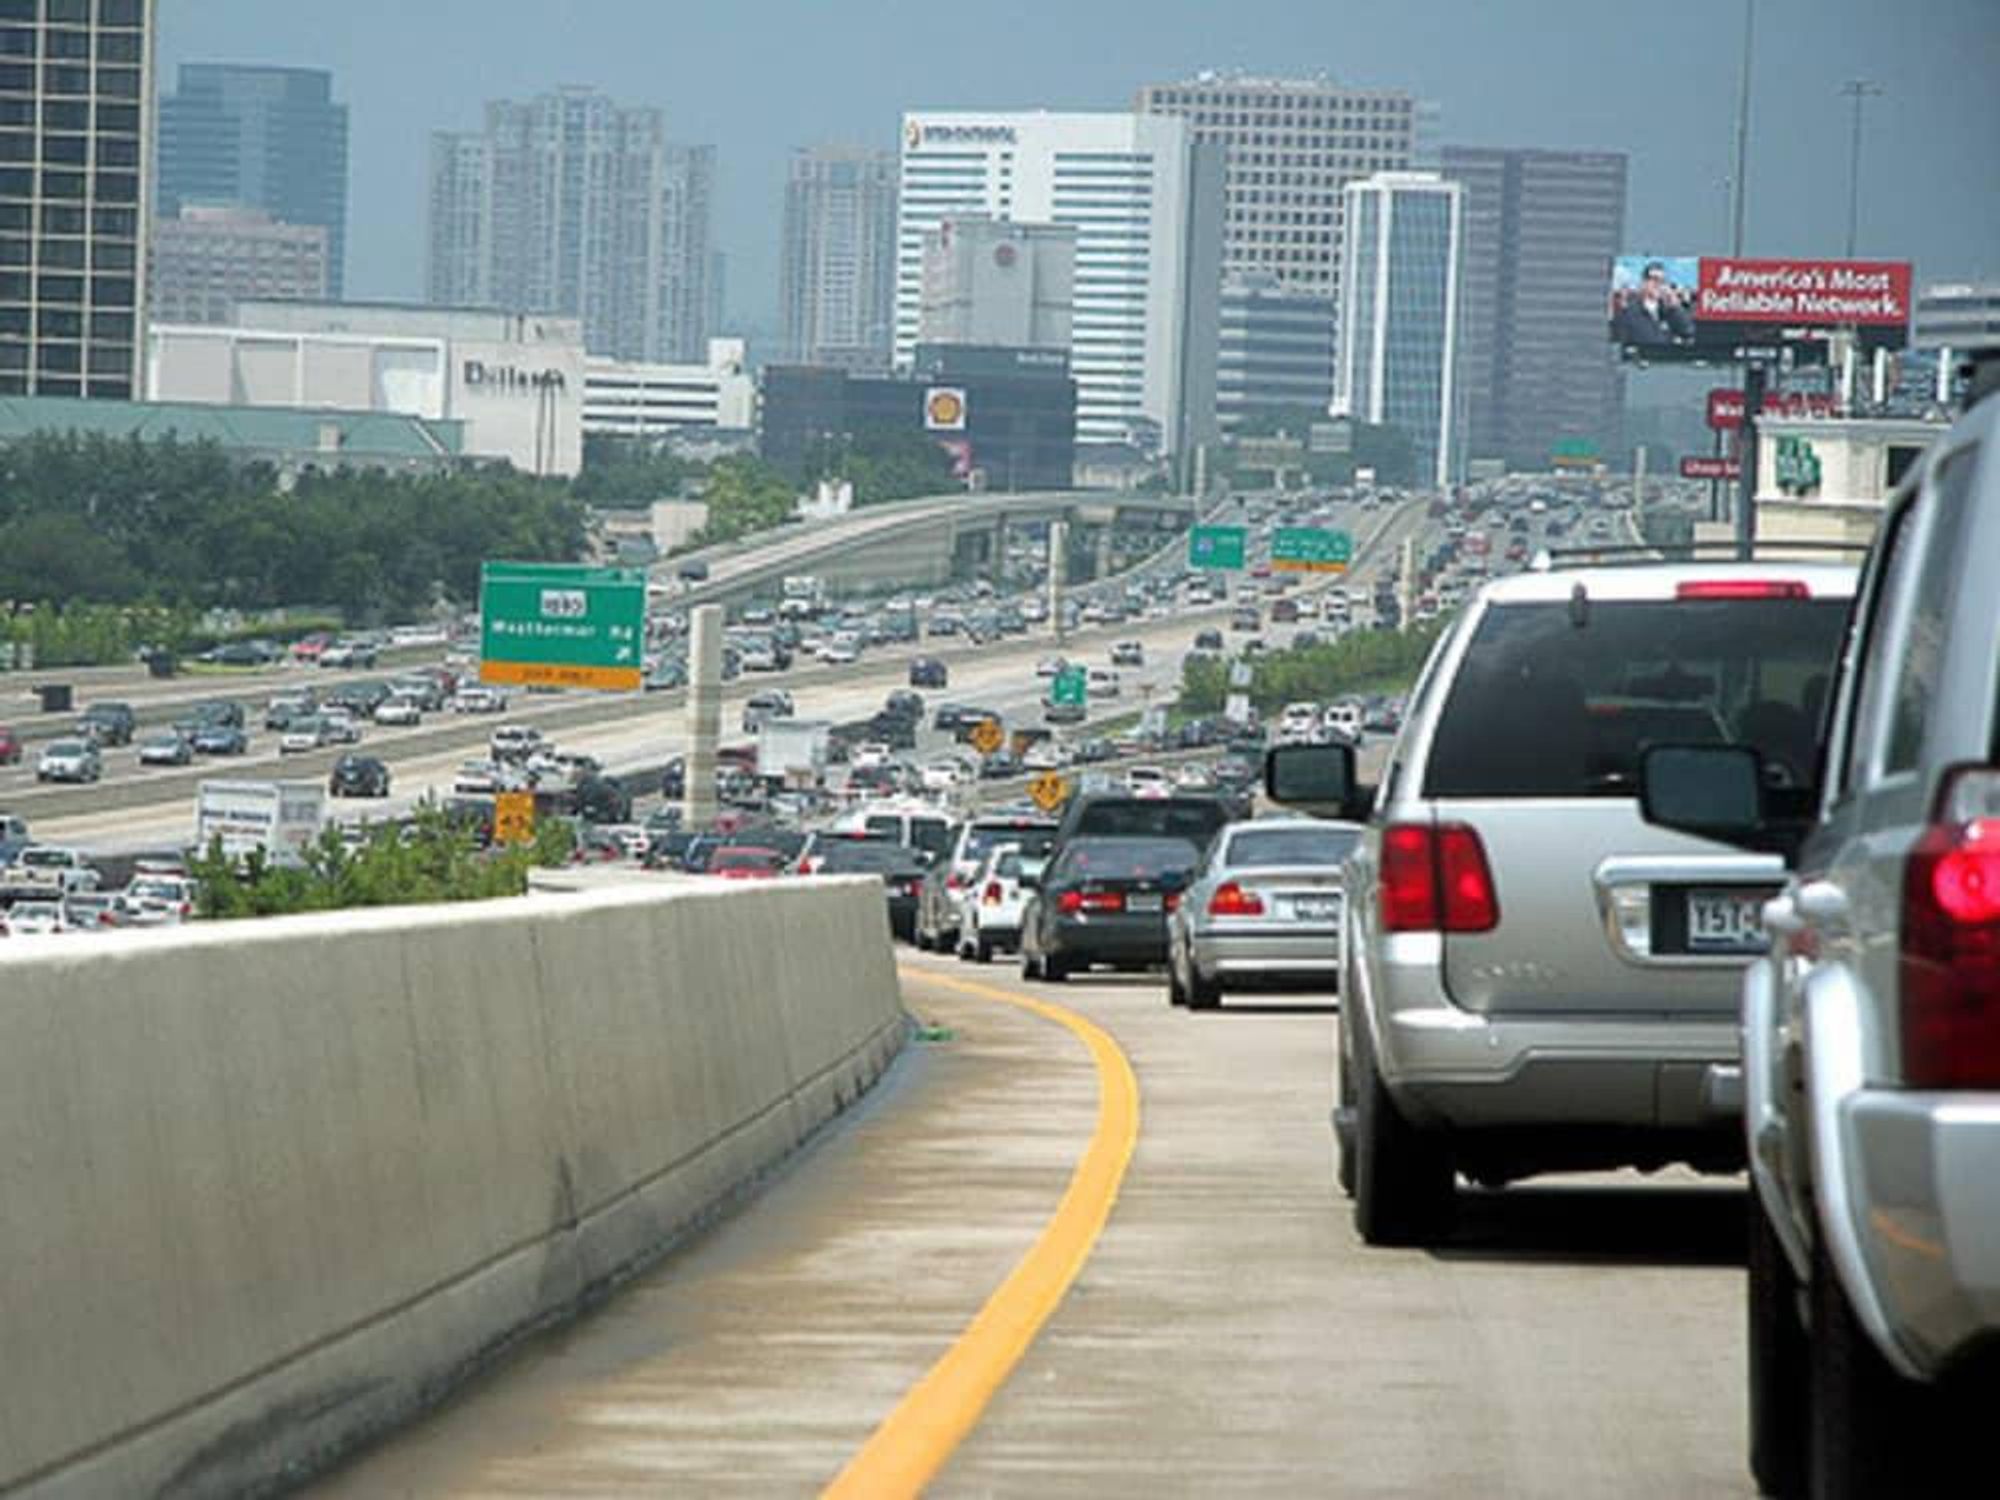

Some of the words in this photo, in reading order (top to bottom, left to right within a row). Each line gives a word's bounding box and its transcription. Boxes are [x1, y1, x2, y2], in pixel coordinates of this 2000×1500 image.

[1717, 266, 1825, 289] America's
[1831, 269, 1889, 290] Most
[1702, 288, 1793, 312] Reliable
